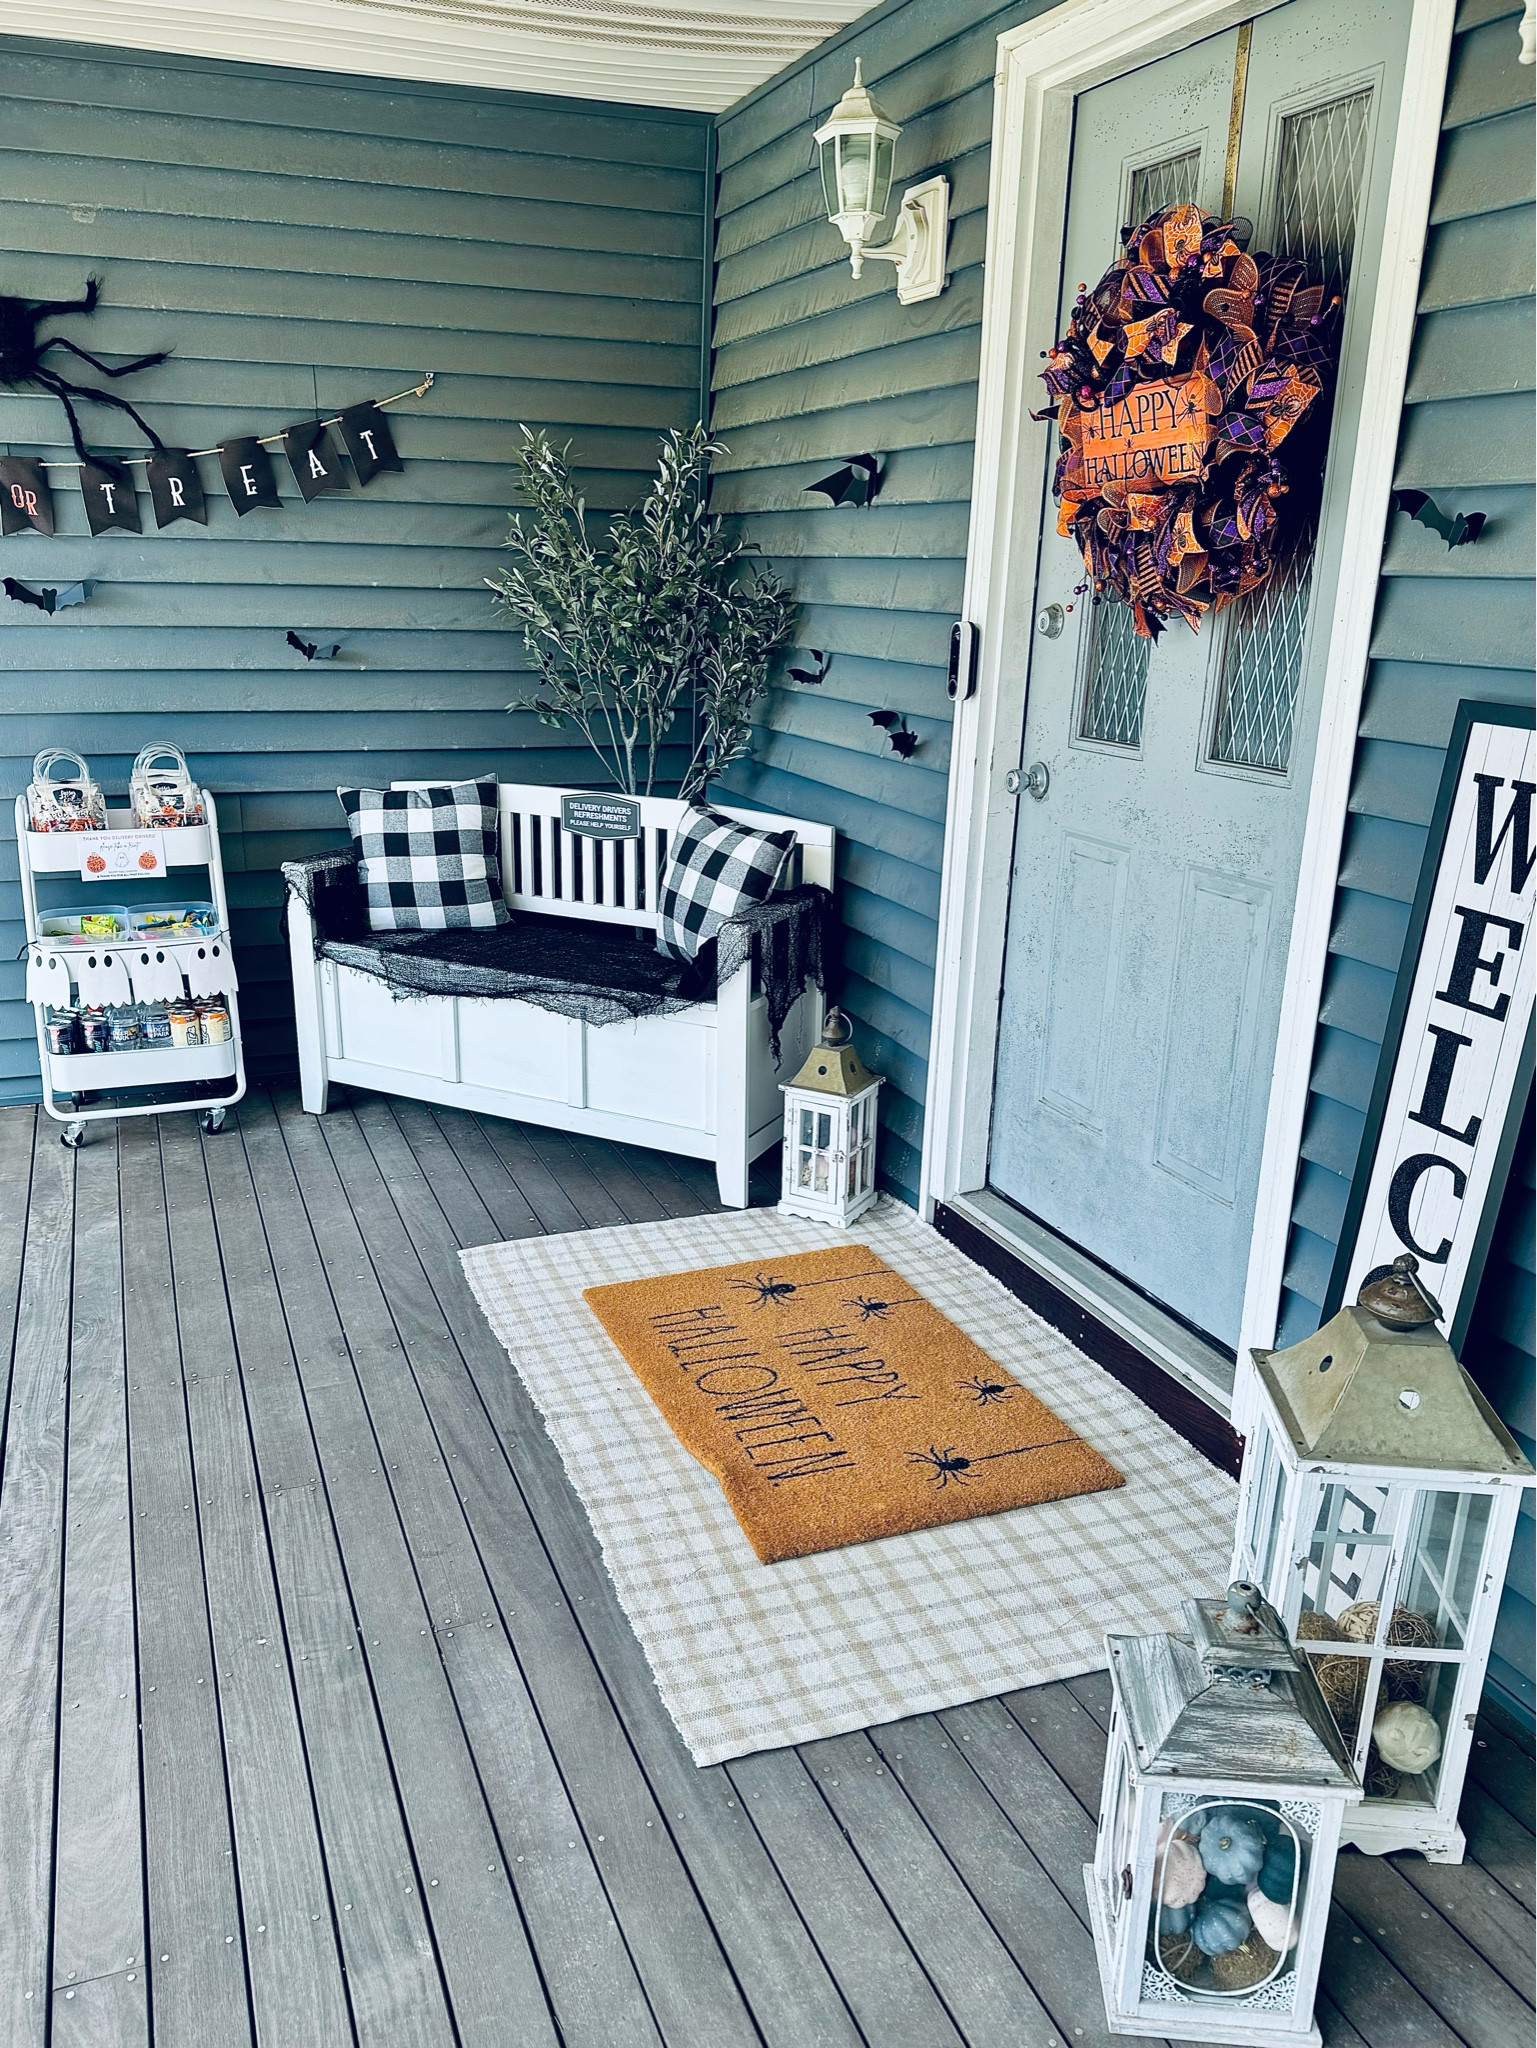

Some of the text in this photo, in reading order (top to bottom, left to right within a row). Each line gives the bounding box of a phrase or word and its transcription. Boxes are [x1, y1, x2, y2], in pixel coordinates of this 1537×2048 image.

[1099, 387, 1182, 440] HAPPY
[1085, 441, 1205, 485] HALLOWEEN
[10, 484, 39, 516] OR
[569, 802, 631, 814] DELIVERY DRIVERS
[574, 811, 627, 822] REFRESHMENTS
[605, 823, 631, 831] YOURSELF
[775, 1324, 921, 1406] HAPPY
